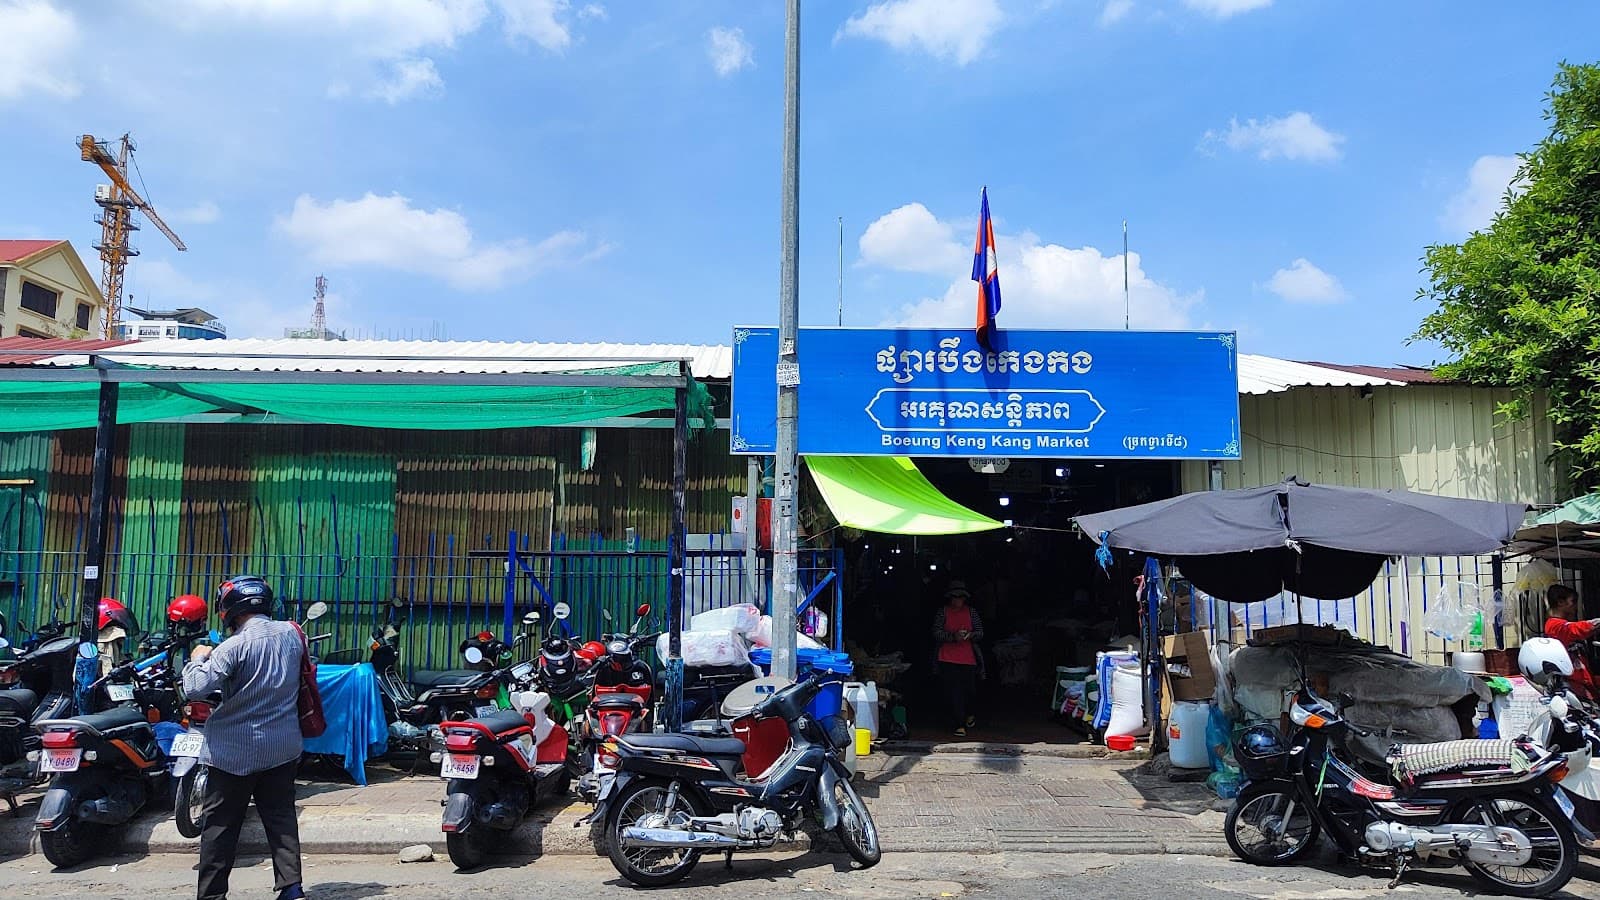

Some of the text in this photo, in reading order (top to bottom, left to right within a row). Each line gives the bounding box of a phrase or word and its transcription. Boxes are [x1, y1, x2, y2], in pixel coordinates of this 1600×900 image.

[876, 337, 1093, 384] ផ្សារបឹងកេងកង
[882, 434, 1090, 450] Boeung Keng Kang Market
